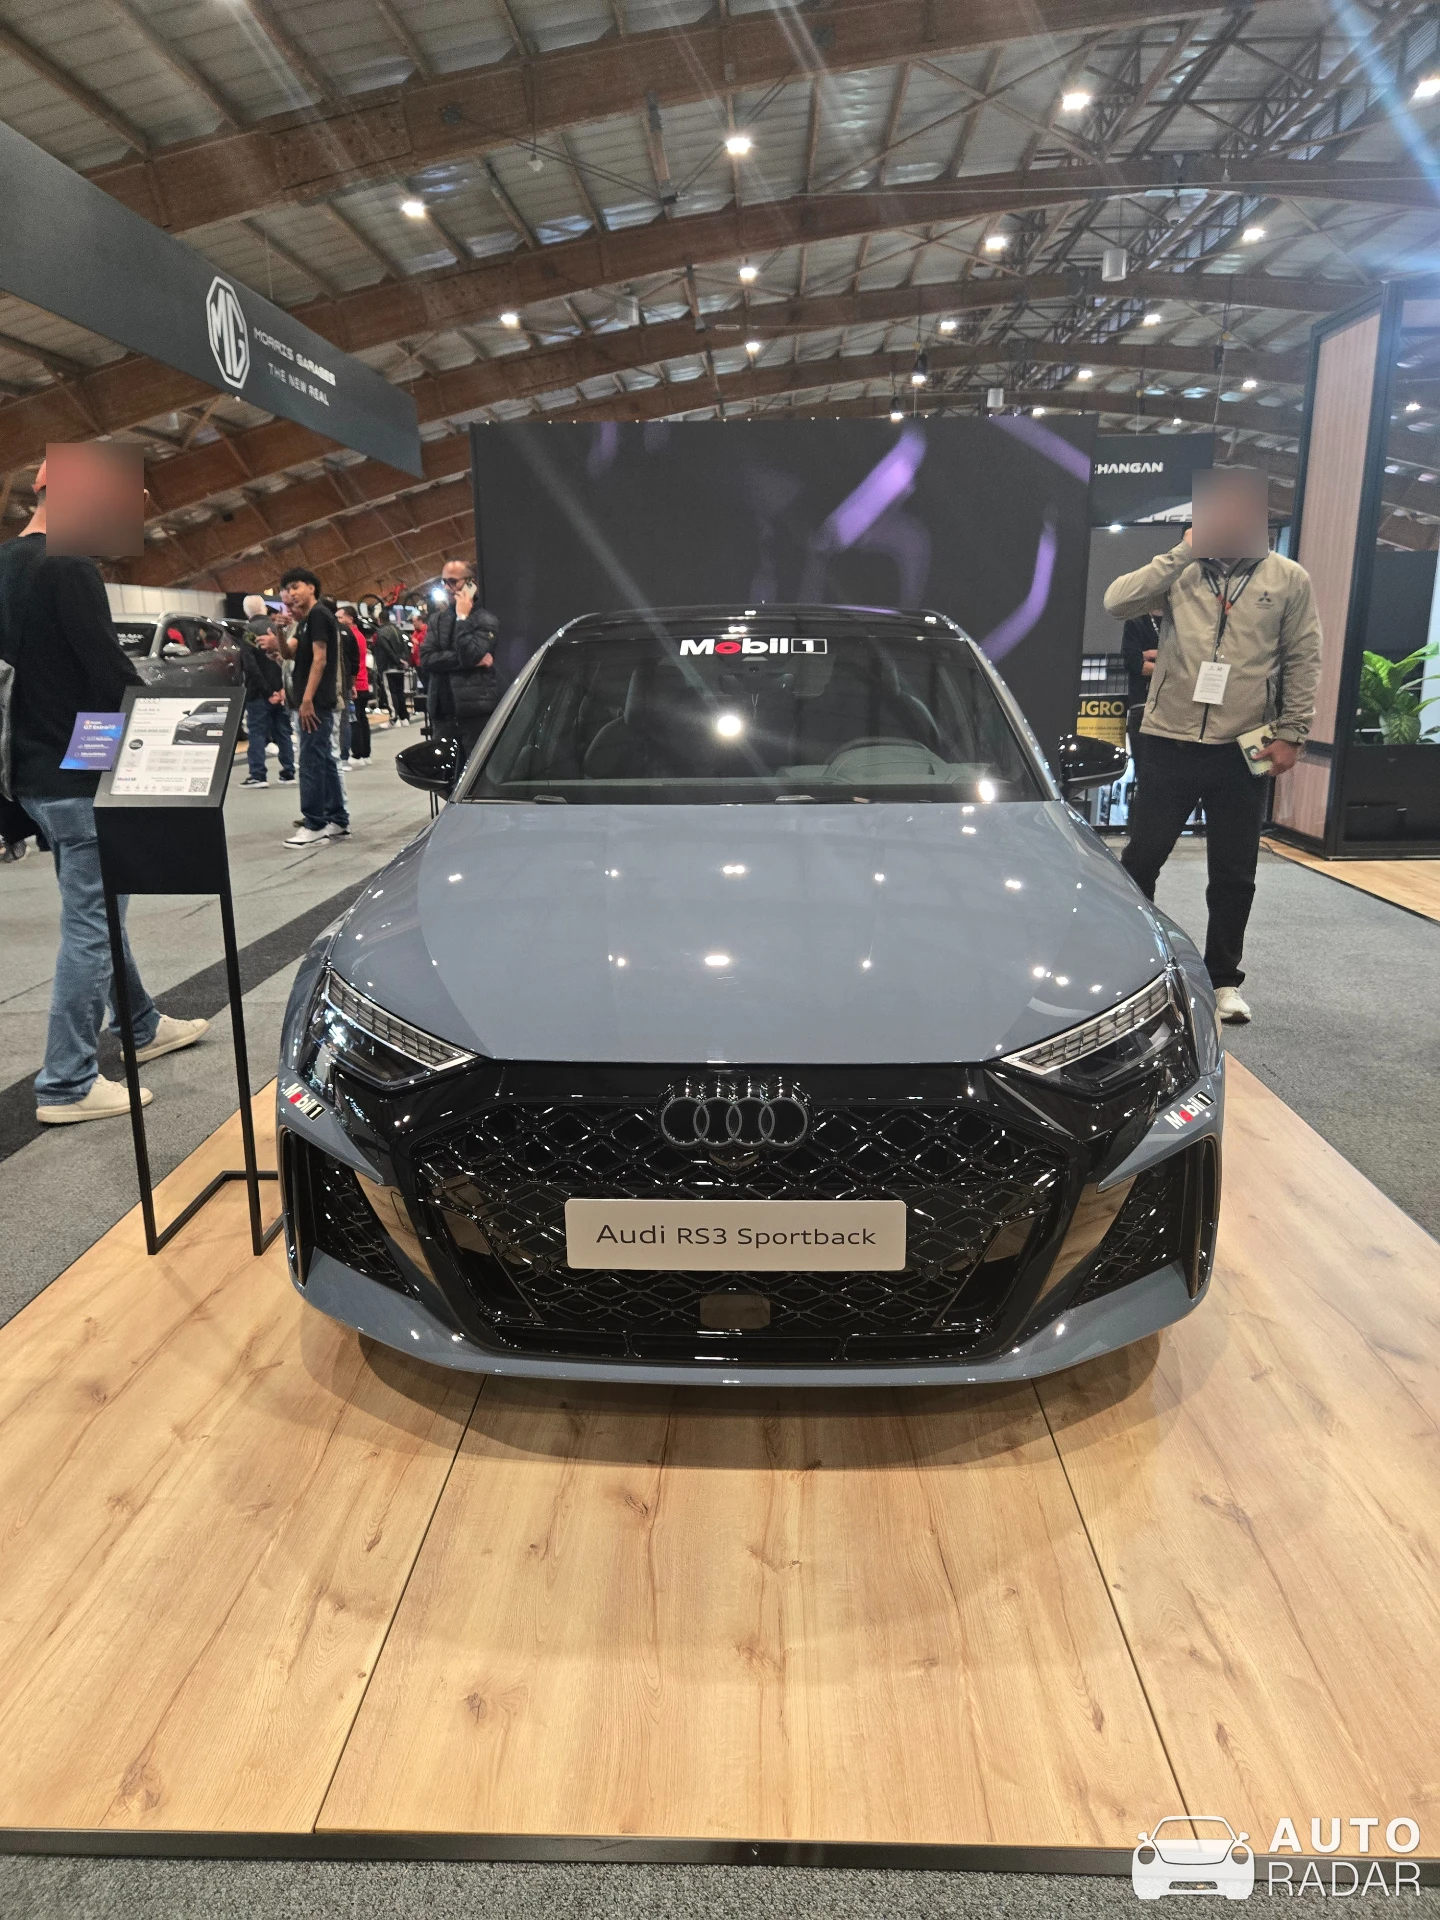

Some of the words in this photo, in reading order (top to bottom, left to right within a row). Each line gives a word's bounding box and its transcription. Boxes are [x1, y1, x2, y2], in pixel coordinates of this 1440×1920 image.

[210, 287, 247, 379] MG
[253, 327, 294, 361] MORRIS
[267, 362, 287, 383] THE
[288, 374, 307, 394] NEW
[308, 384, 330, 406] REAL
[1094, 462, 1164, 474] HANGAN
[680, 638, 789, 655] Mobil
[1078, 701, 1125, 716] IGRO
[283, 1082, 318, 1113] Mobil
[1163, 1097, 1206, 1130] Mobil
[596, 1224, 665, 1245] Audi
[677, 1228, 727, 1245] RS3
[737, 1228, 876, 1249] Sportback
